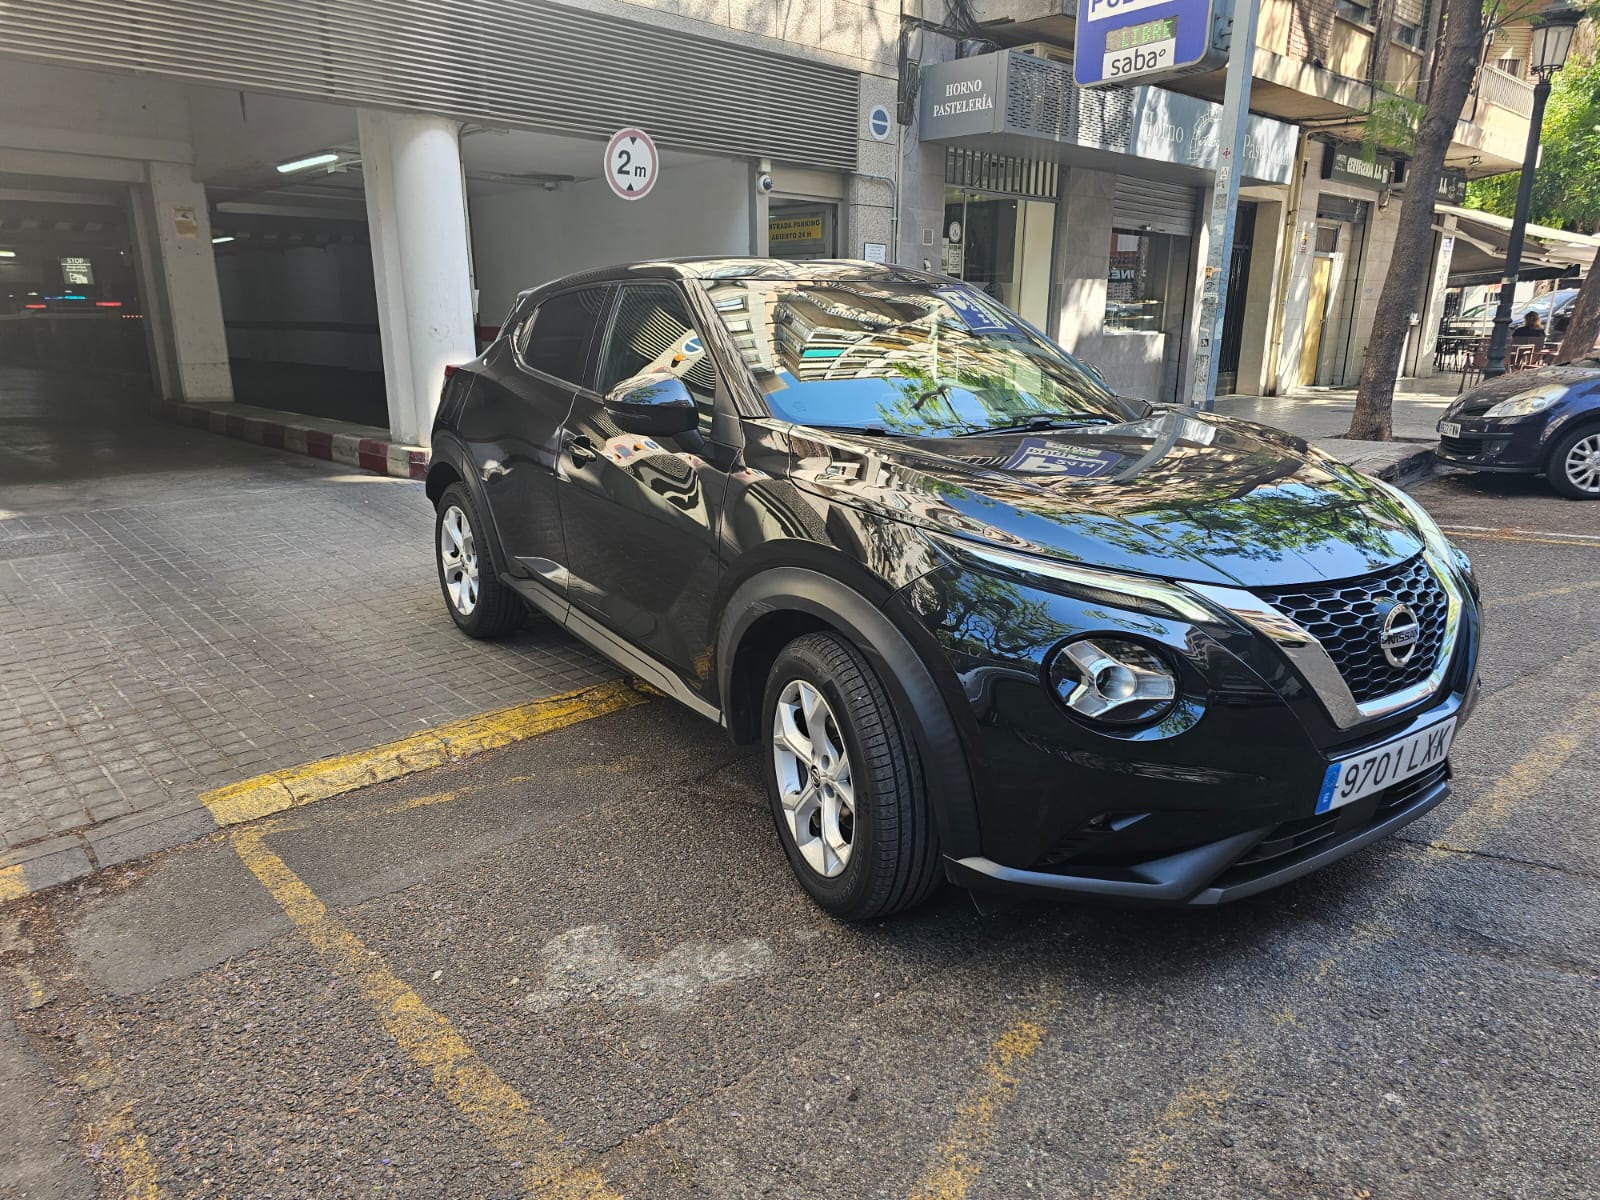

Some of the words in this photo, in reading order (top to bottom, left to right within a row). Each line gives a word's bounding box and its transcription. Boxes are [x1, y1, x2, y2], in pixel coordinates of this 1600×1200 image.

[1120, 20, 1174, 48] LIBRE
[945, 79, 982, 97] HORNO
[933, 93, 993, 117] PASTELERÍA
[1141, 111, 1184, 143] Horno
[617, 149, 631, 175] 2
[634, 165, 647, 178] m
[1340, 745, 1404, 798] 9701
[1407, 725, 1451, 773] LXK
